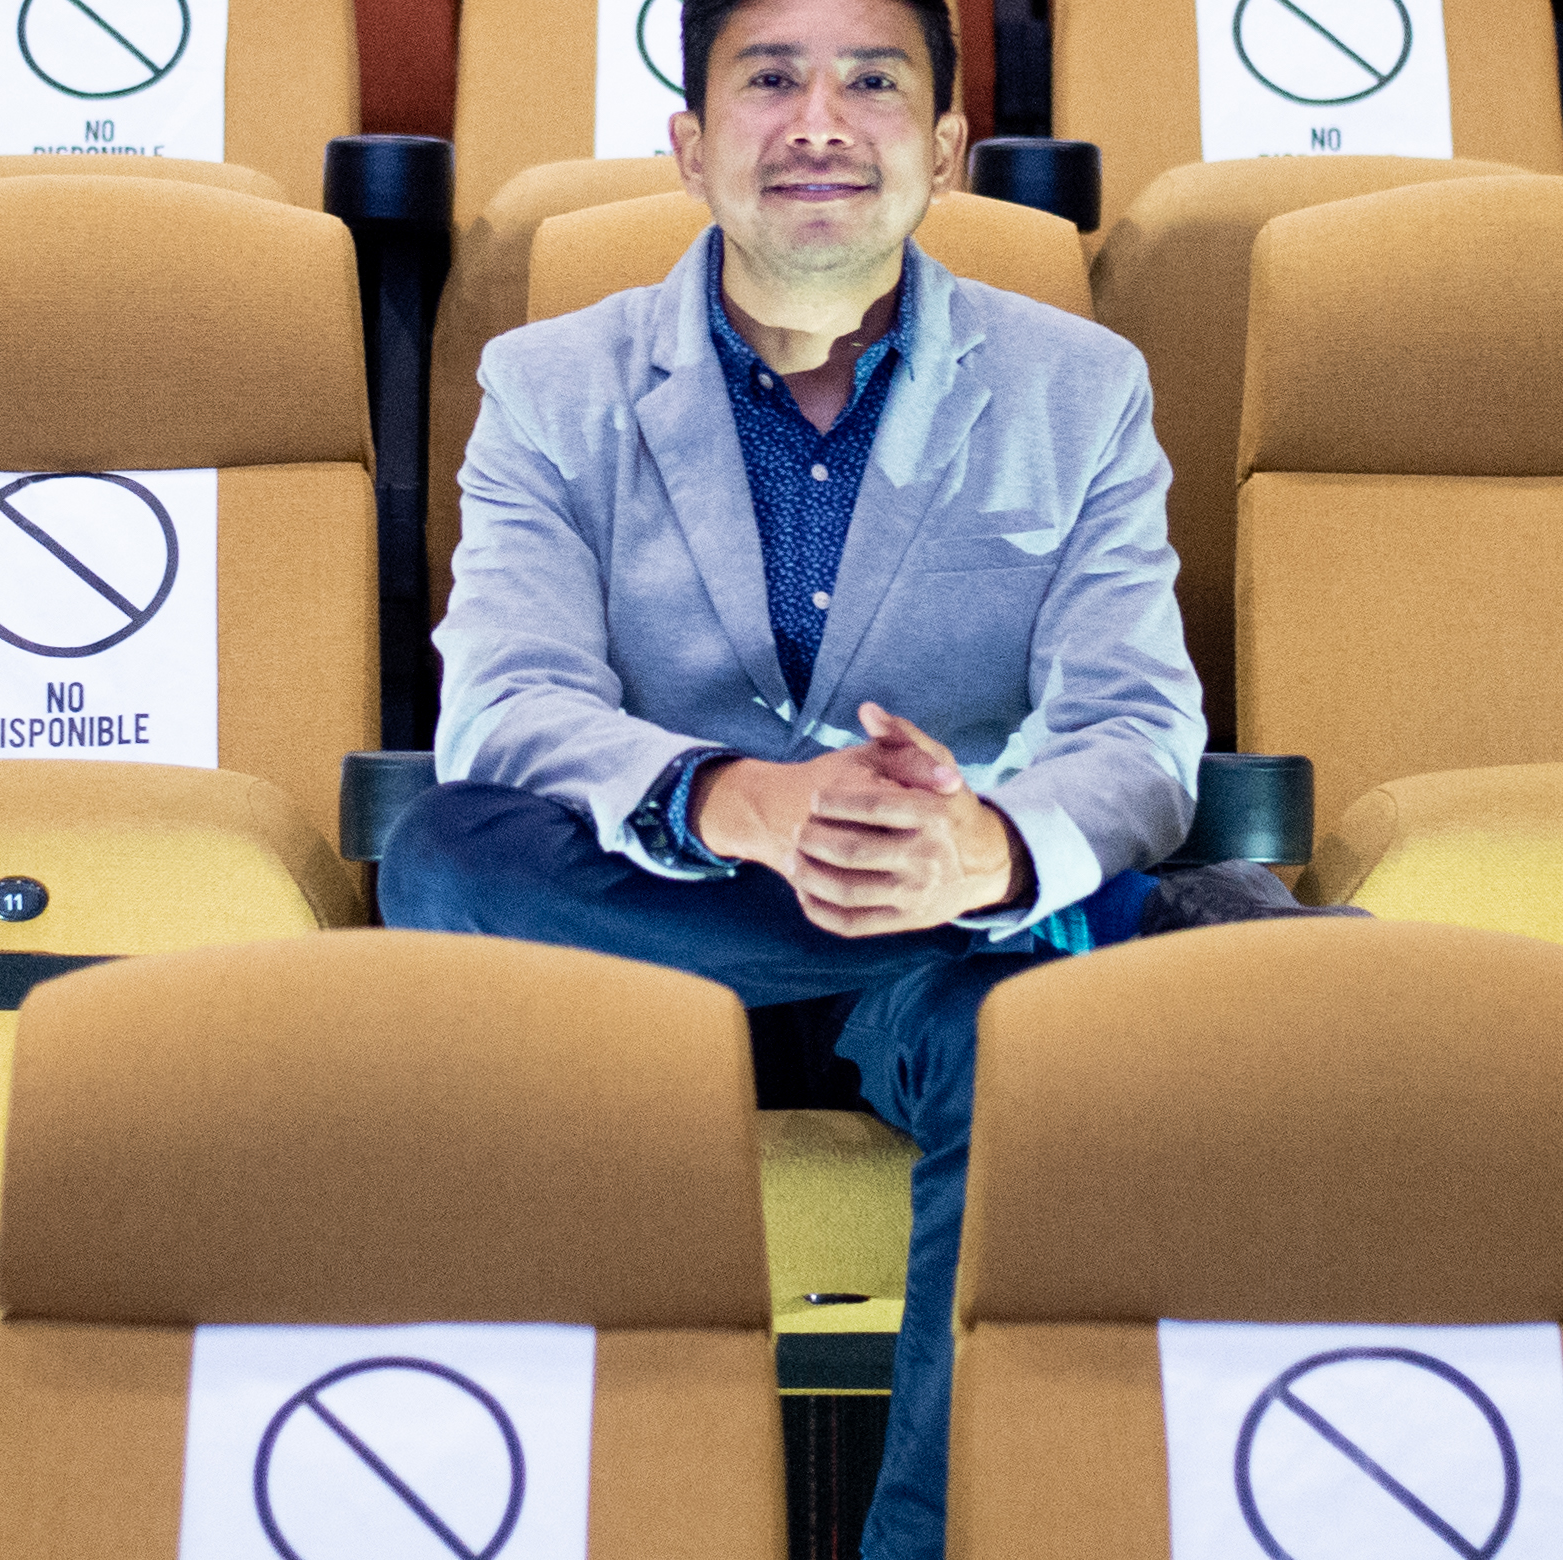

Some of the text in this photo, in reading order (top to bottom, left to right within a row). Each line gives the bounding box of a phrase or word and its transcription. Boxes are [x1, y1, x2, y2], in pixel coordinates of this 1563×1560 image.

[84, 119, 115, 142] NO
[1310, 126, 1341, 151] NO
[46, 681, 84, 713] NO
[3, 893, 23, 911] 11
